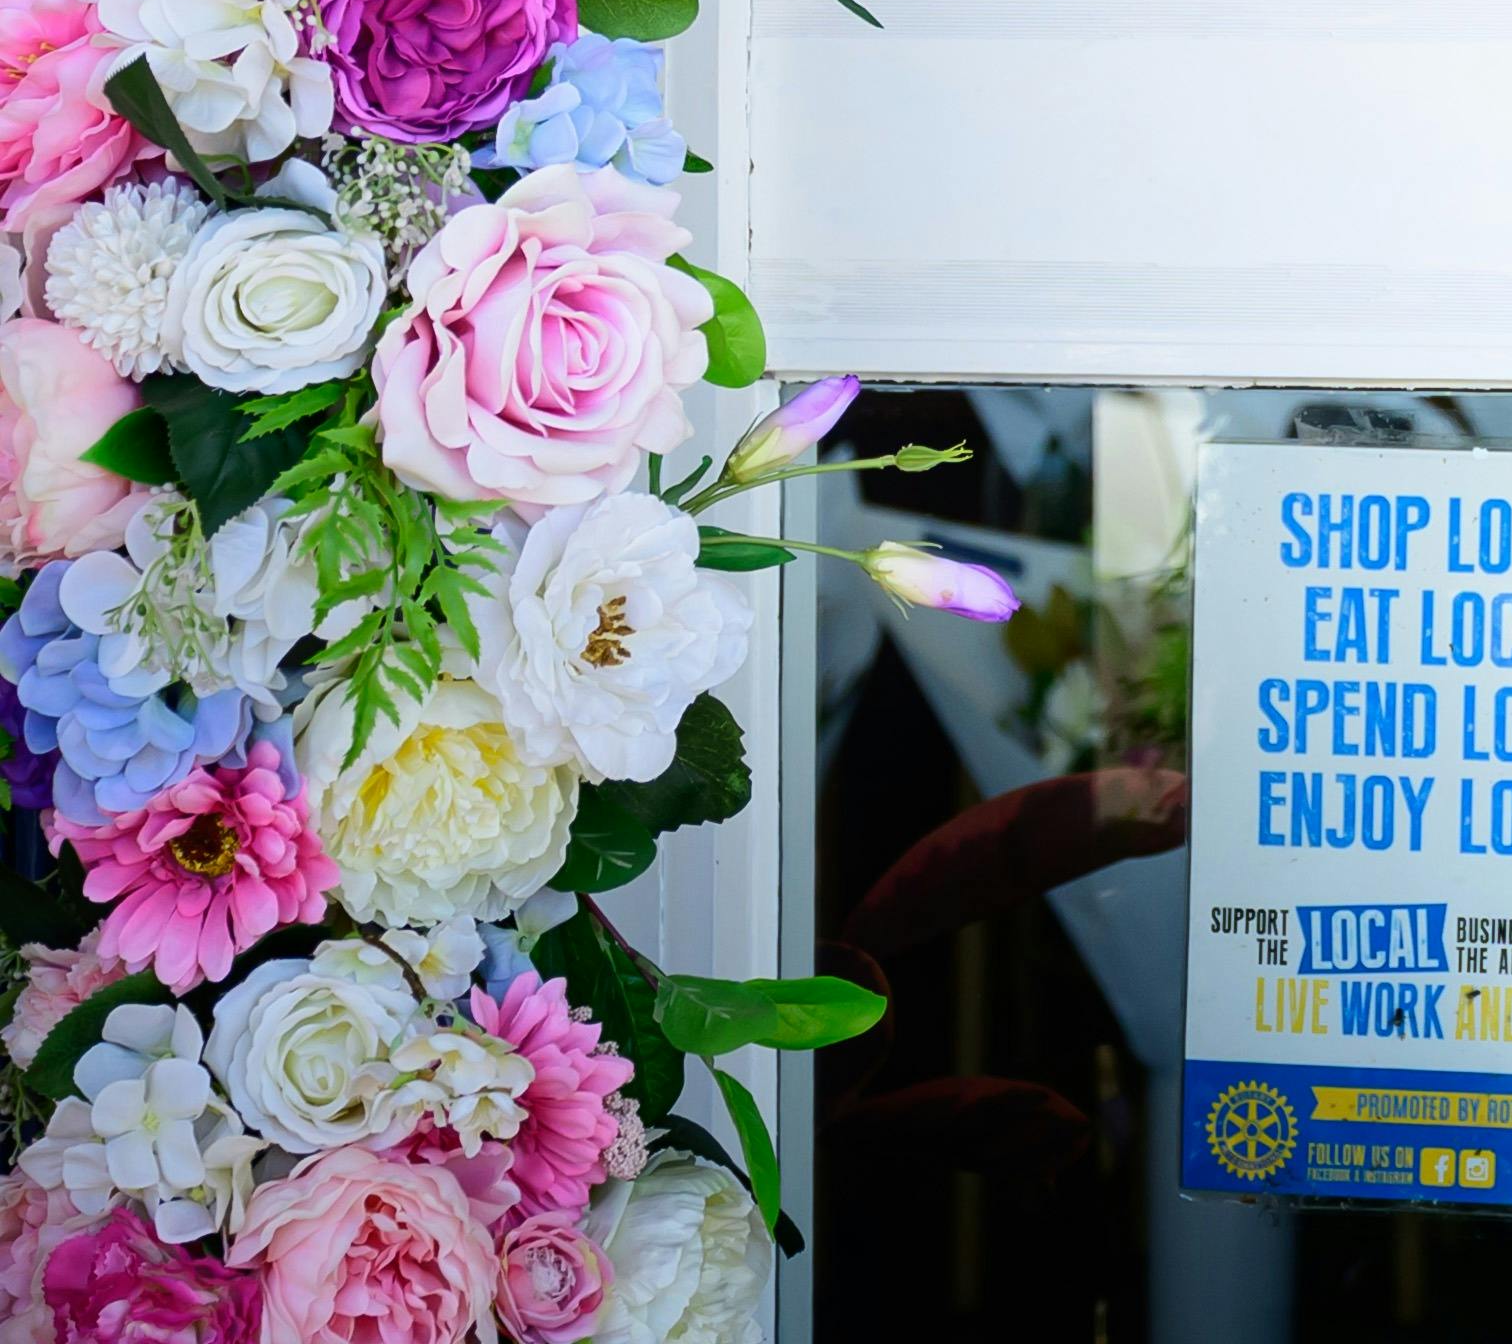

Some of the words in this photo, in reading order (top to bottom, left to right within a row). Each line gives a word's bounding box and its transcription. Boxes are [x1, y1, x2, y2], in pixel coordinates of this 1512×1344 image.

[1280, 492, 1431, 572] SHOP
[1304, 586, 1400, 665] EAT
[1257, 678, 1437, 759] SPEND
[1257, 770, 1435, 852] ENJOY
[1211, 906, 1290, 937] SUPPORT
[1257, 937, 1289, 967] THE
[1310, 909, 1440, 971] LOCAL
[1456, 947, 1489, 974] THE
[1255, 977, 1330, 1035] LIVE
[1340, 981, 1446, 1040] WORK
[1356, 1093, 1450, 1122] PROMOTED
[1457, 1097, 1481, 1123] BY
[1307, 1142, 1366, 1167] FOLLOW
[1371, 1145, 1390, 1169] US
[1395, 1146, 1415, 1169] ON
